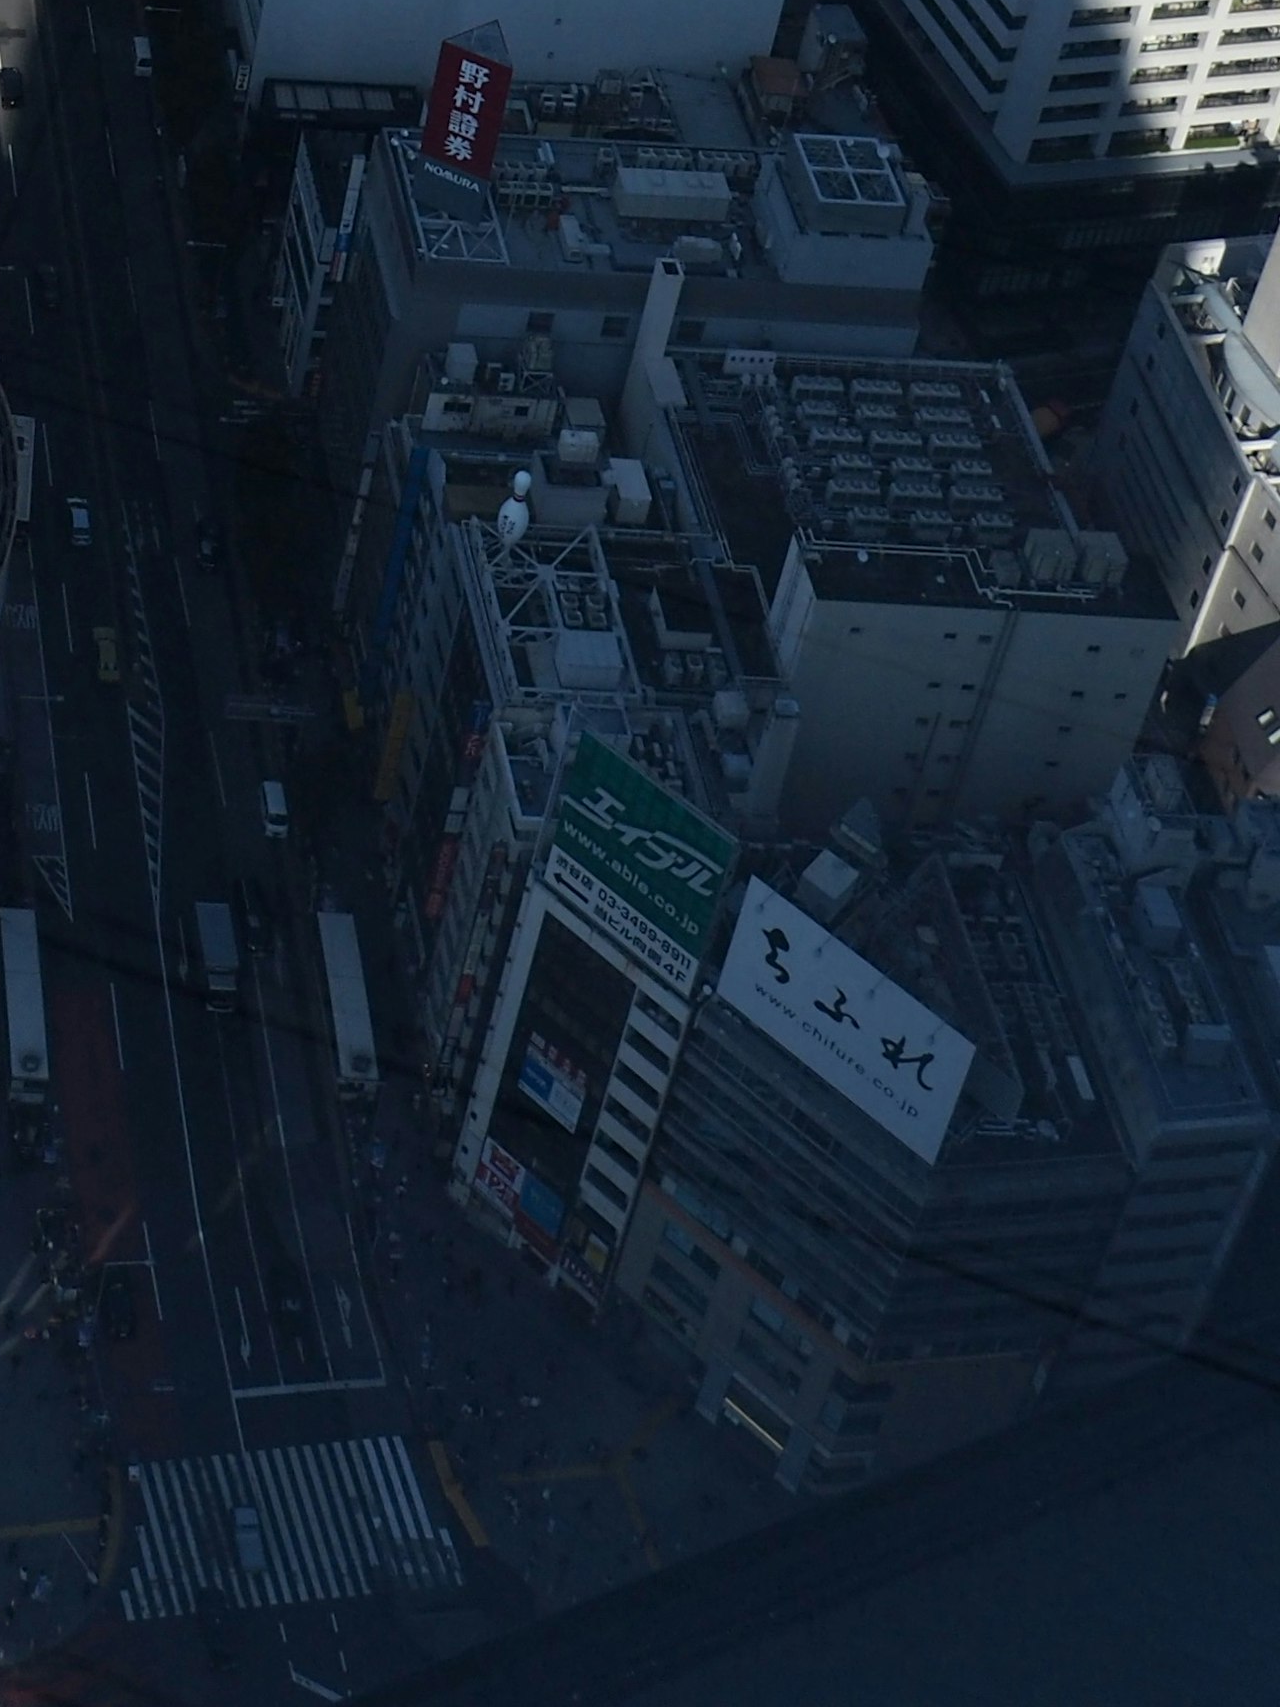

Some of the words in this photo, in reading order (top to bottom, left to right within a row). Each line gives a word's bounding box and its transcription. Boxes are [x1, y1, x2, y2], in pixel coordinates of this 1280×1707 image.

[443, 58, 491, 162] 野村證券
[424, 161, 481, 193] NOMURA
[561, 786, 724, 899] エイブル
[561, 818, 701, 939] www.able.co.jp
[598, 886, 693, 973] 03-3499-8911
[664, 958, 687, 984] 4F
[754, 982, 921, 1119] www.chifure.co.jp
[761, 927, 938, 1092] ちふれ
